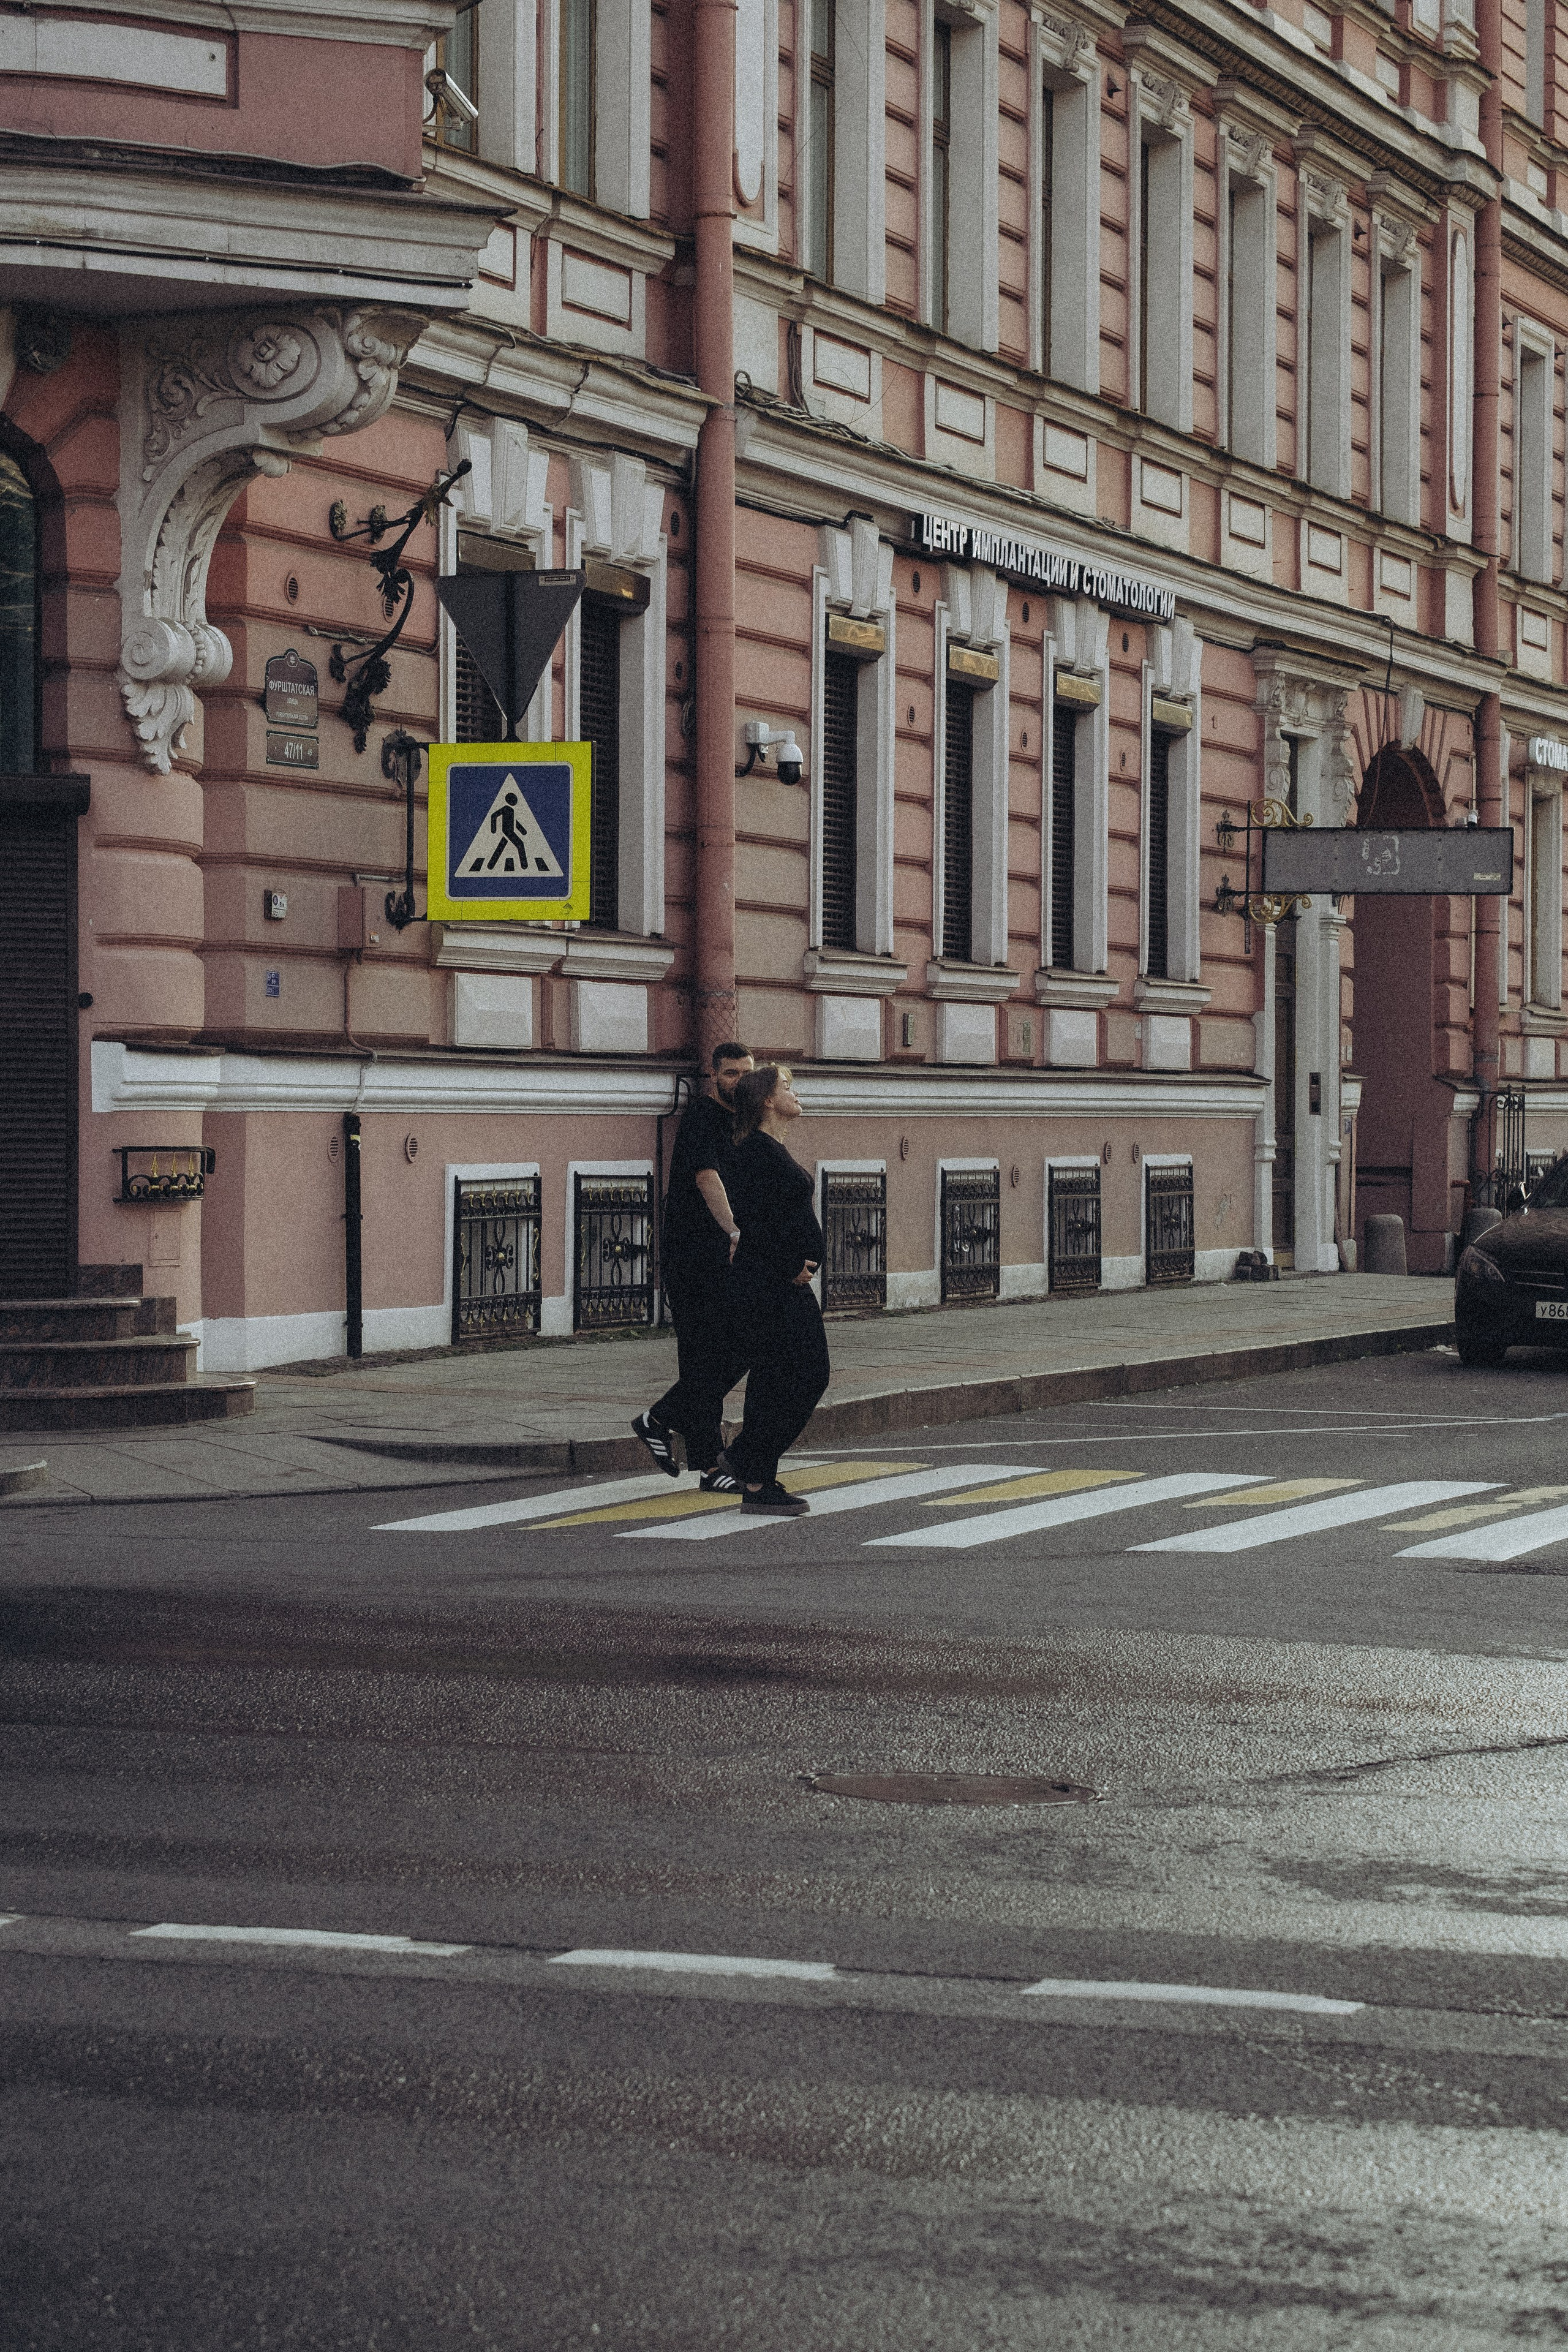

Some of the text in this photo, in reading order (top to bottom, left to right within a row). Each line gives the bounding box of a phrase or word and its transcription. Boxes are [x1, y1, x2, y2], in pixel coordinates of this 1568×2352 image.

[923, 514, 1175, 619] ЦЕНТР ИМПЛАНТАЦИИ И СТОМАТОЛОГИИ
[269, 680, 315, 696] ФУРШТАТСКАЯ
[284, 742, 303, 760] 47/11
[1540, 1304, 1568, 1317] У86
